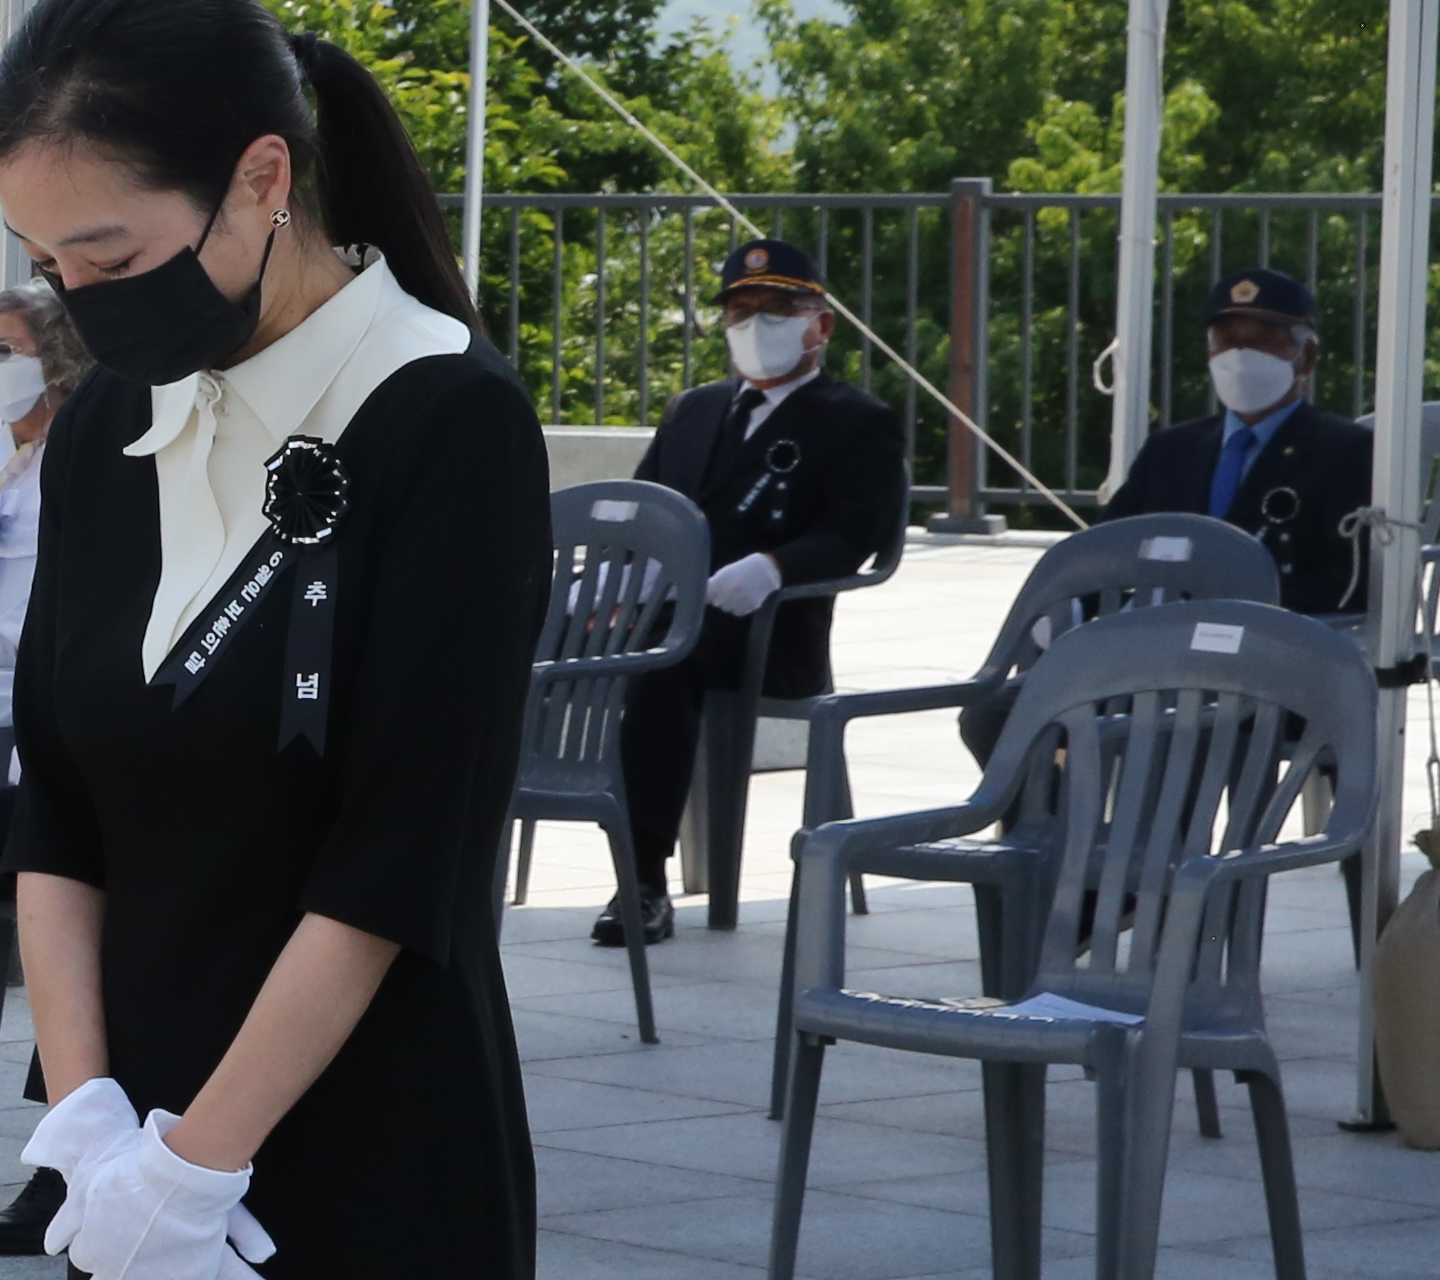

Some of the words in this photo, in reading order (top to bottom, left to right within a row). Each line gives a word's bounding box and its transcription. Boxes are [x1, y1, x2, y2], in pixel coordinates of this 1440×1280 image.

[240, 551, 284, 603] 6월은
[200, 599, 245, 656] 보훈의
[184, 650, 206, 675] 달
